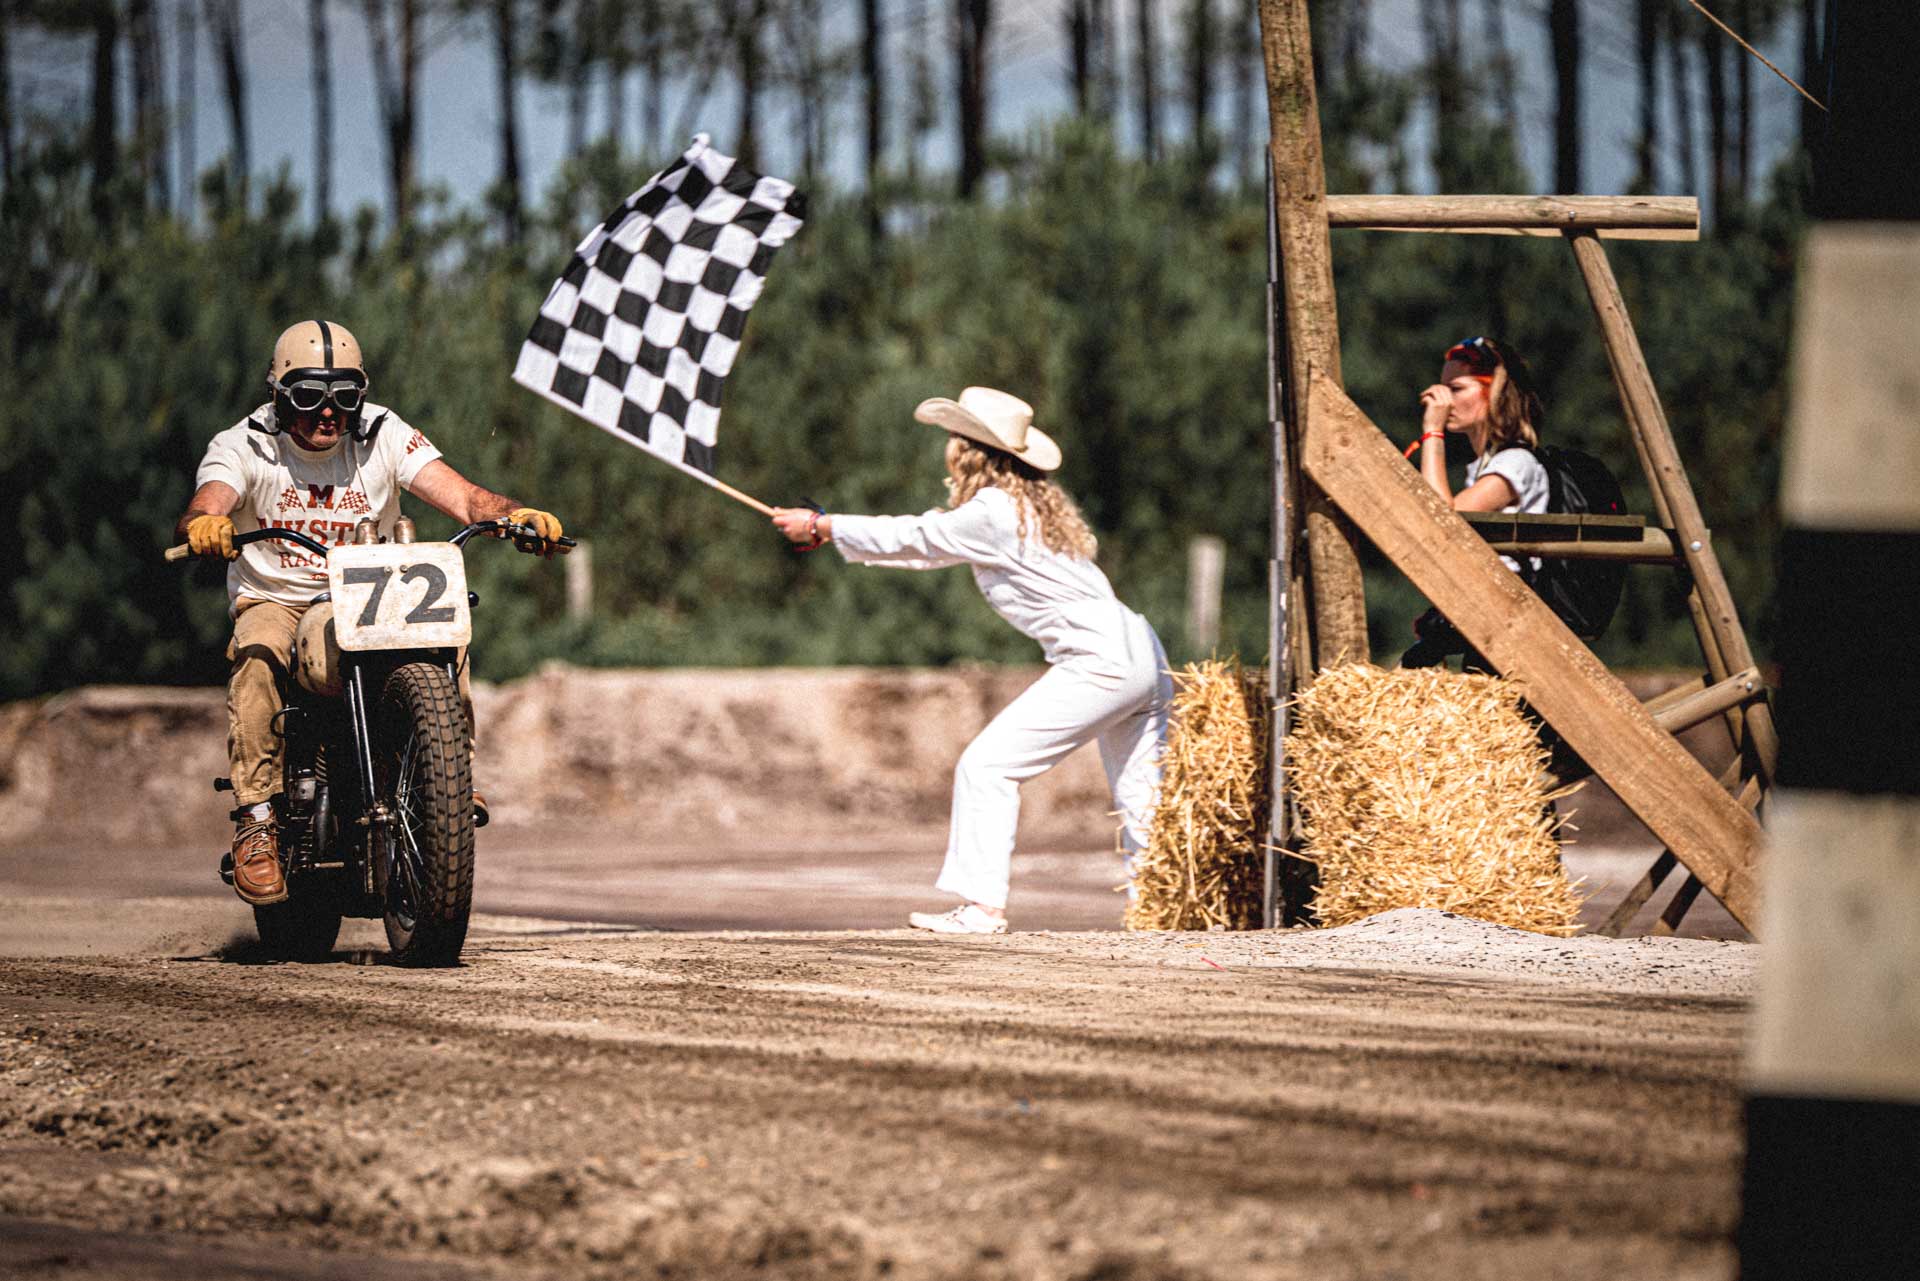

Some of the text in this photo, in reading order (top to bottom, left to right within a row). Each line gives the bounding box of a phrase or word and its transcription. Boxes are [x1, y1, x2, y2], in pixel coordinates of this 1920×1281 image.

[307, 484, 334, 509] M
[256, 517, 358, 546] MYST
[343, 563, 456, 626] 72
